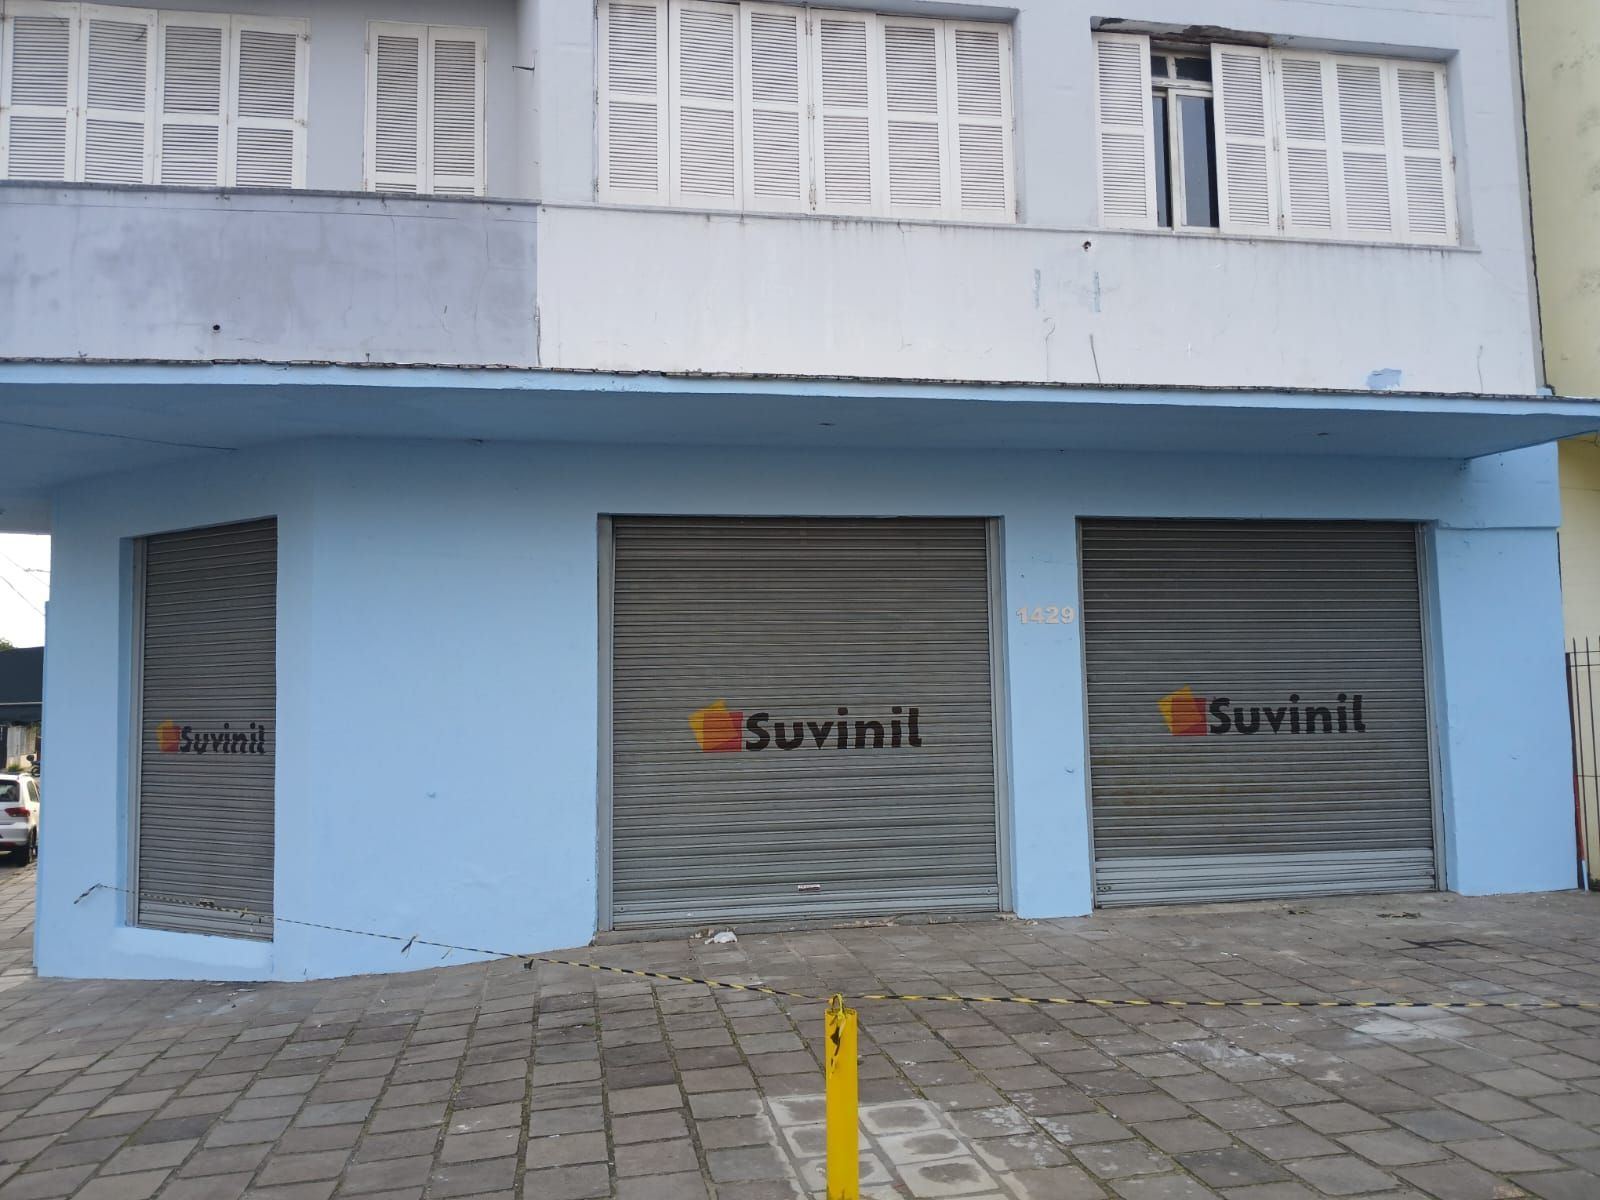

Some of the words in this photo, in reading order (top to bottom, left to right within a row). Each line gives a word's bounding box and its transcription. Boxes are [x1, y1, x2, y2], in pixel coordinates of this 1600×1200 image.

[1018, 605, 1075, 624] 1429
[744, 706, 922, 751] Suvinil
[1209, 693, 1366, 735] Suvinil
[179, 722, 265, 754] Suvinil
